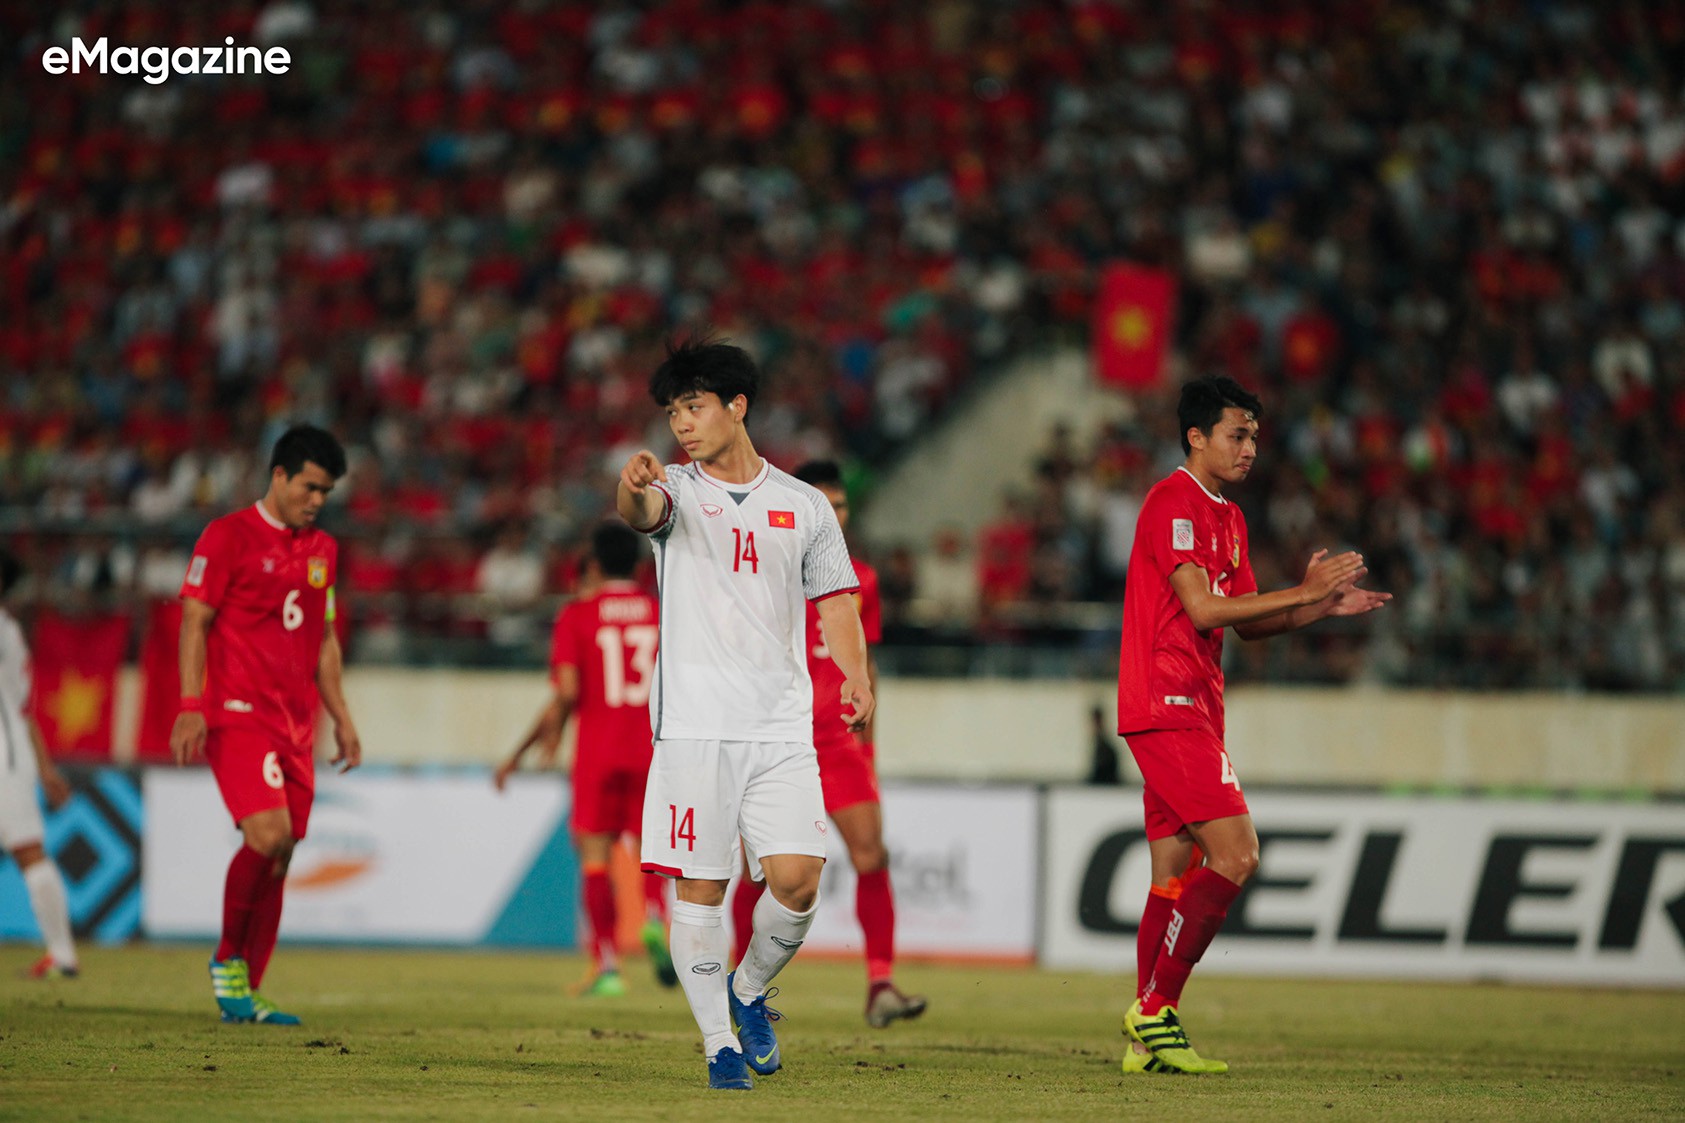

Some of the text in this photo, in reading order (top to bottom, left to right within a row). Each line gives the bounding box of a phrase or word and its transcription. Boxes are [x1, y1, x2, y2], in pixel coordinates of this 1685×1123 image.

[732, 527, 759, 574] 14
[283, 589, 304, 631] 6
[595, 625, 659, 708] 13
[262, 751, 285, 789] 6
[1220, 751, 1240, 791] 4
[669, 804, 696, 852] 14
[1164, 908, 1185, 957] FBT
